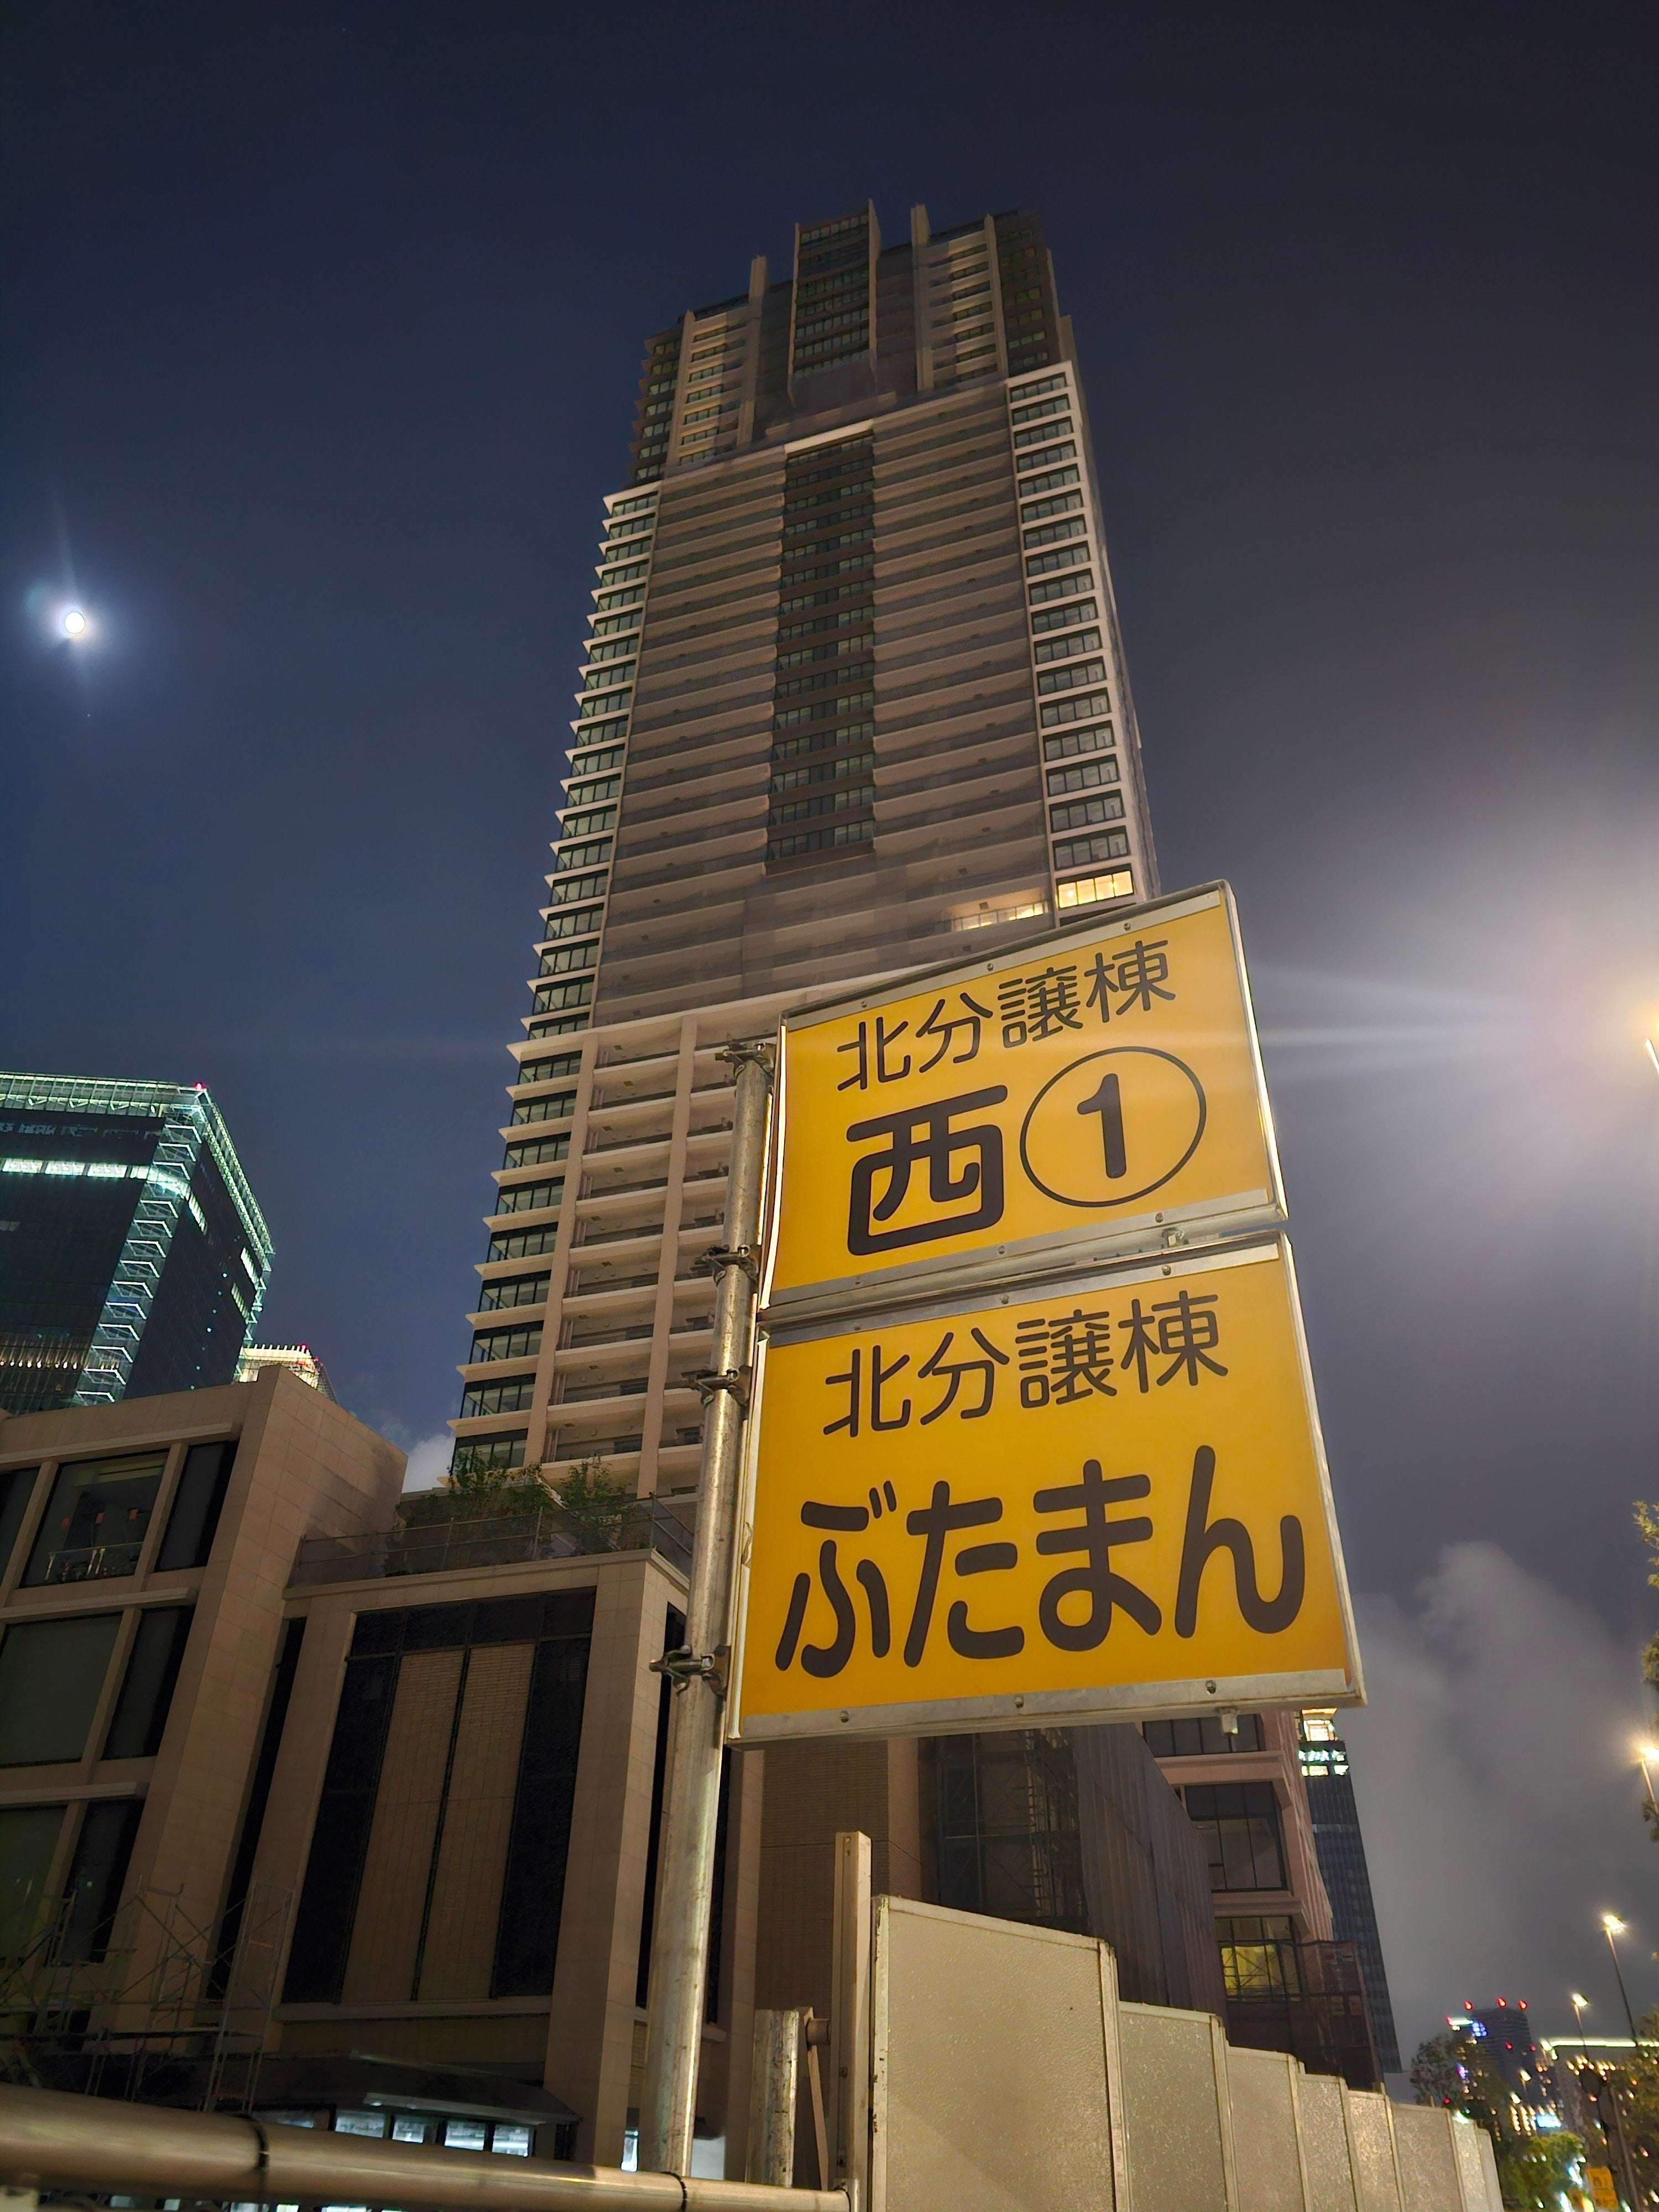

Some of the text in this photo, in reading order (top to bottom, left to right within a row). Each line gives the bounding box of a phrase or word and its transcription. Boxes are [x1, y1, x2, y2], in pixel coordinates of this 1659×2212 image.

[837, 940, 1175, 1091] 北分譲棟
[823, 1291, 1229, 1438] 北分譲棟
[775, 1445, 1306, 1679] ぶたまん
